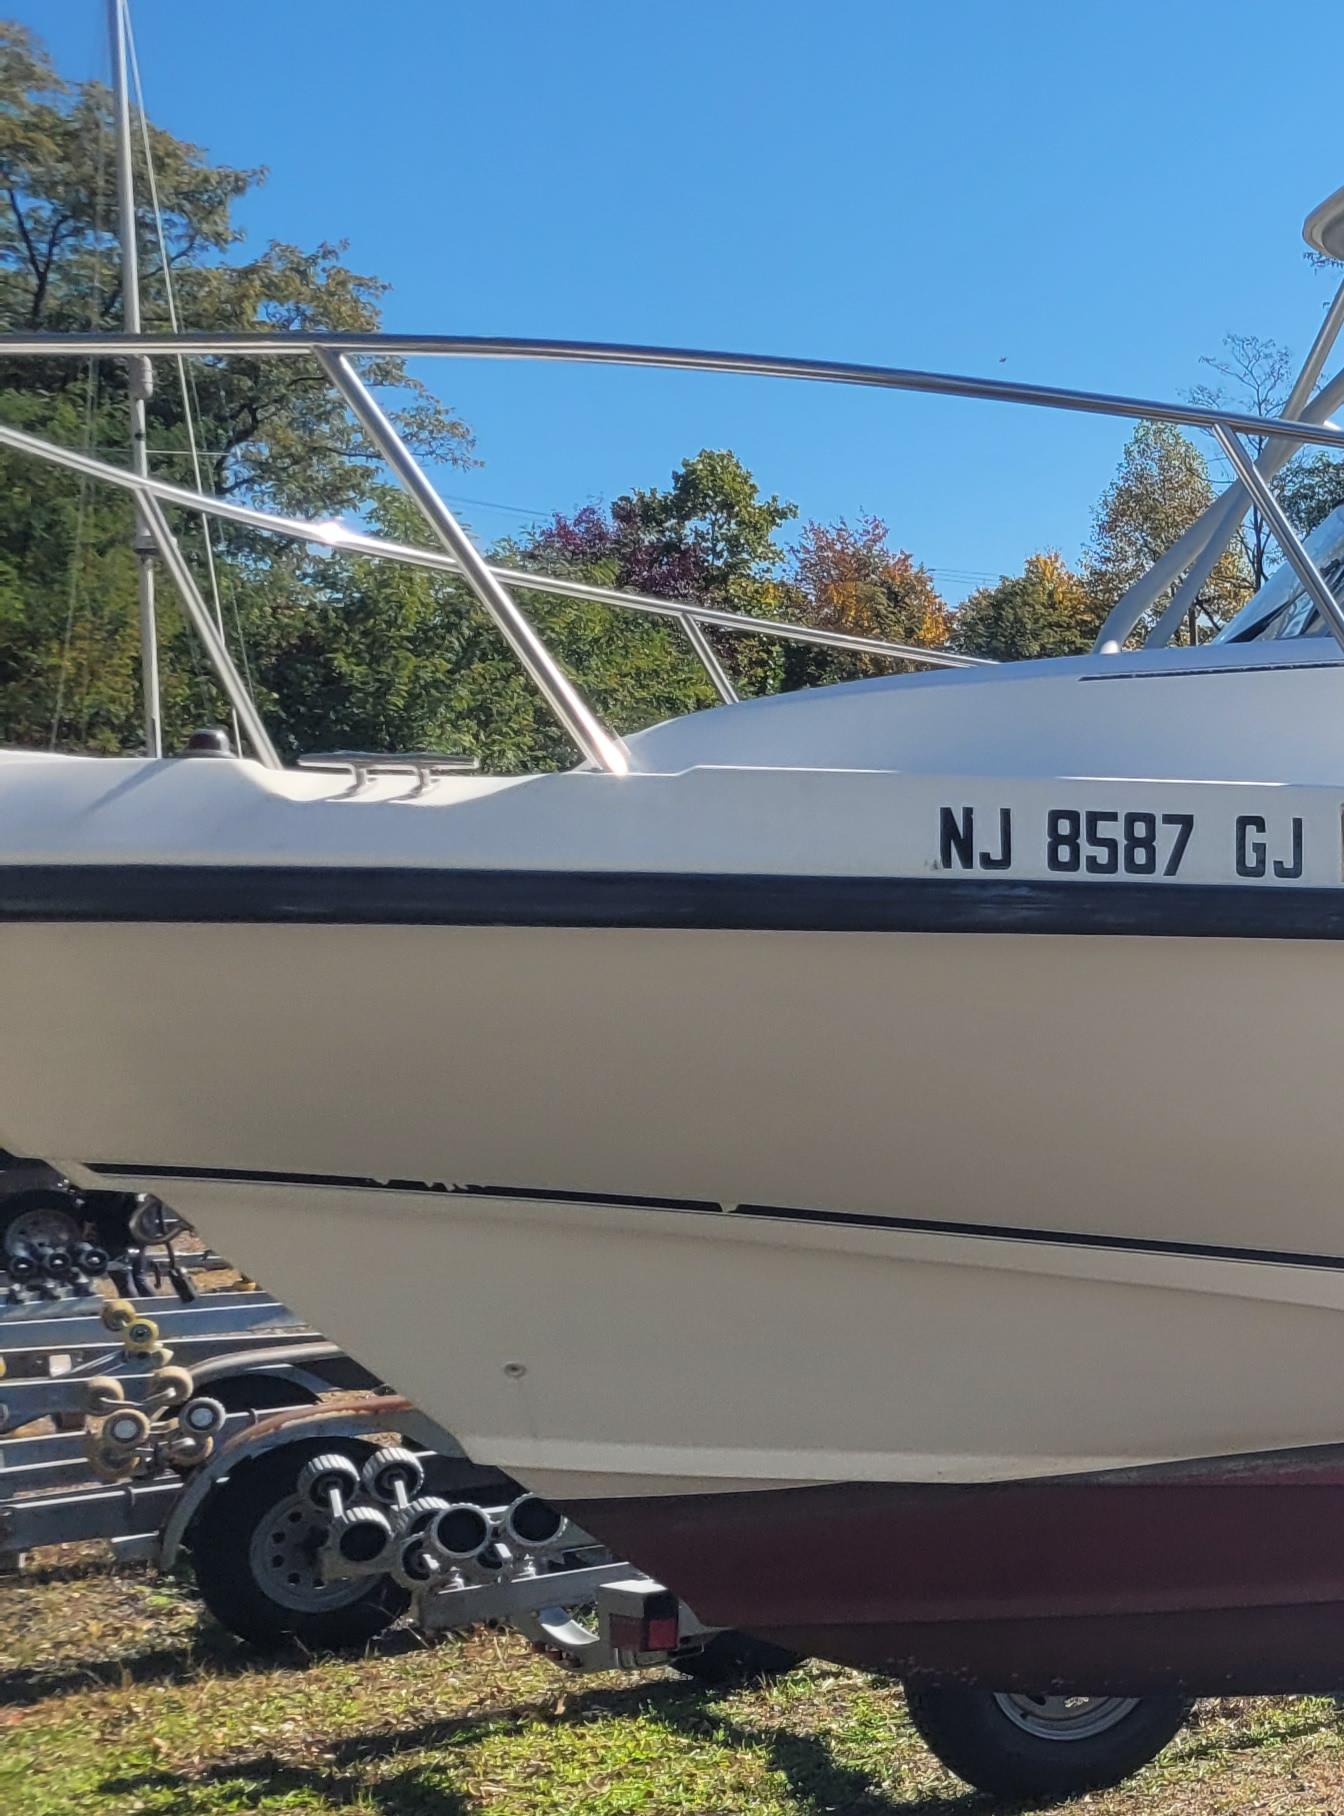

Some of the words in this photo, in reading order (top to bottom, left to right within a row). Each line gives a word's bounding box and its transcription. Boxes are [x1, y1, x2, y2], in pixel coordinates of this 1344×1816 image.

[939, 806, 1012, 871] NJ
[1047, 809, 1195, 877] 8587
[1235, 815, 1303, 879] GJ
